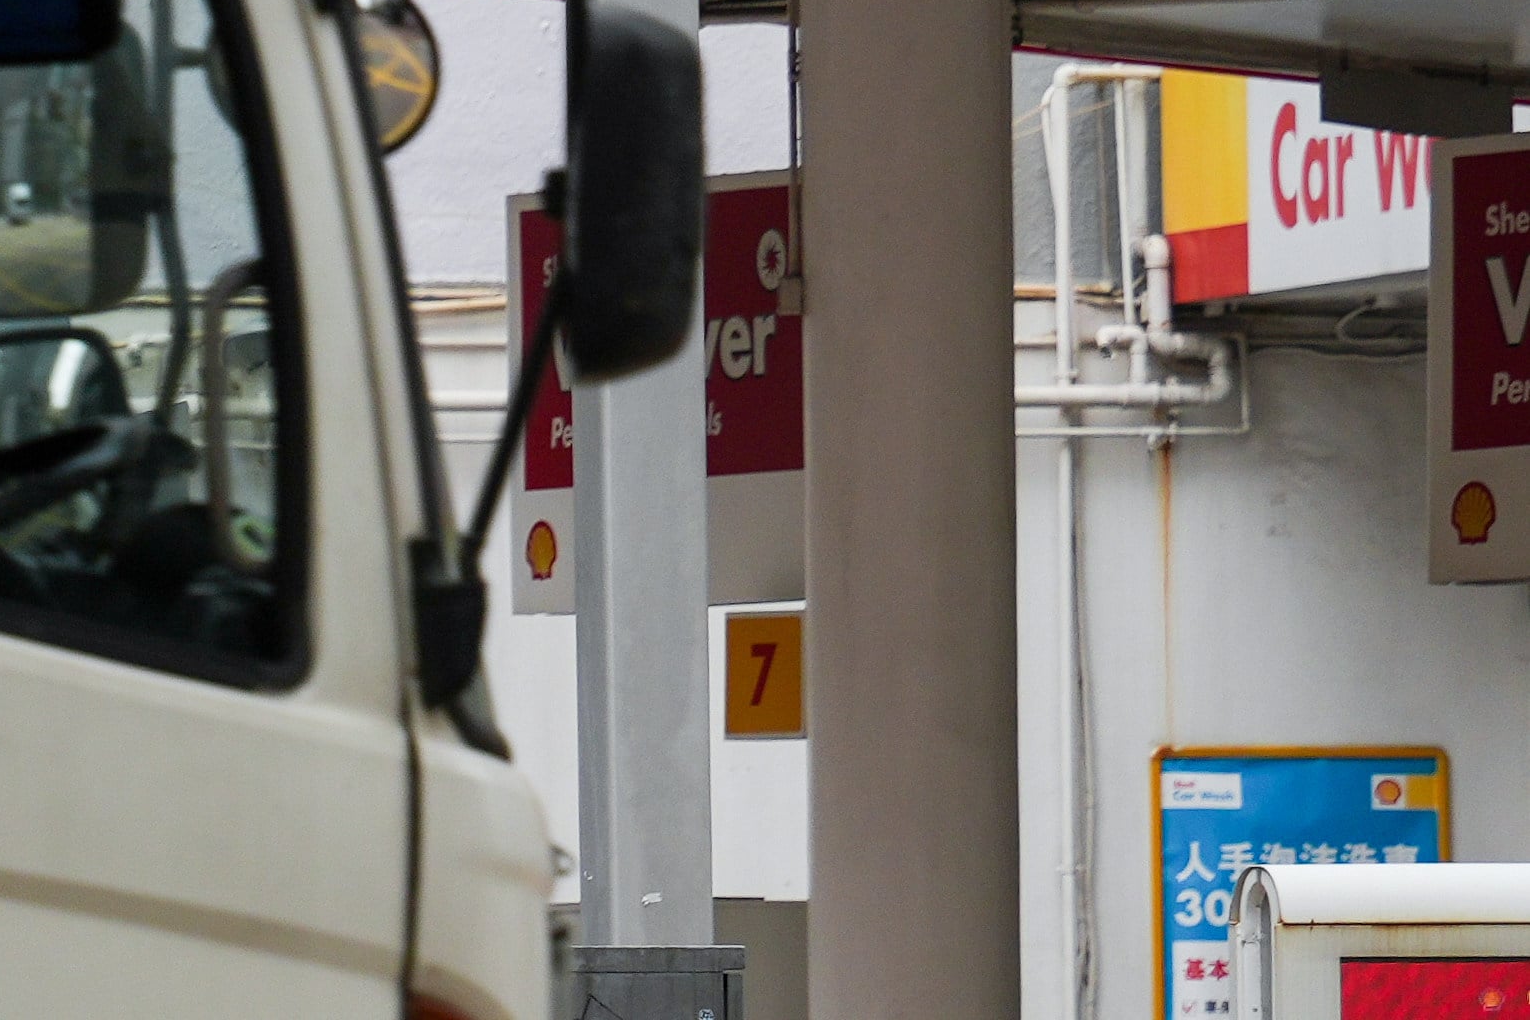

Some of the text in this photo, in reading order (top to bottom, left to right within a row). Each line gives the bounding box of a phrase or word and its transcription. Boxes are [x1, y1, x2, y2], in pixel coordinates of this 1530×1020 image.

[1270, 102, 1432, 229] Car W
[749, 642, 778, 707] 7
